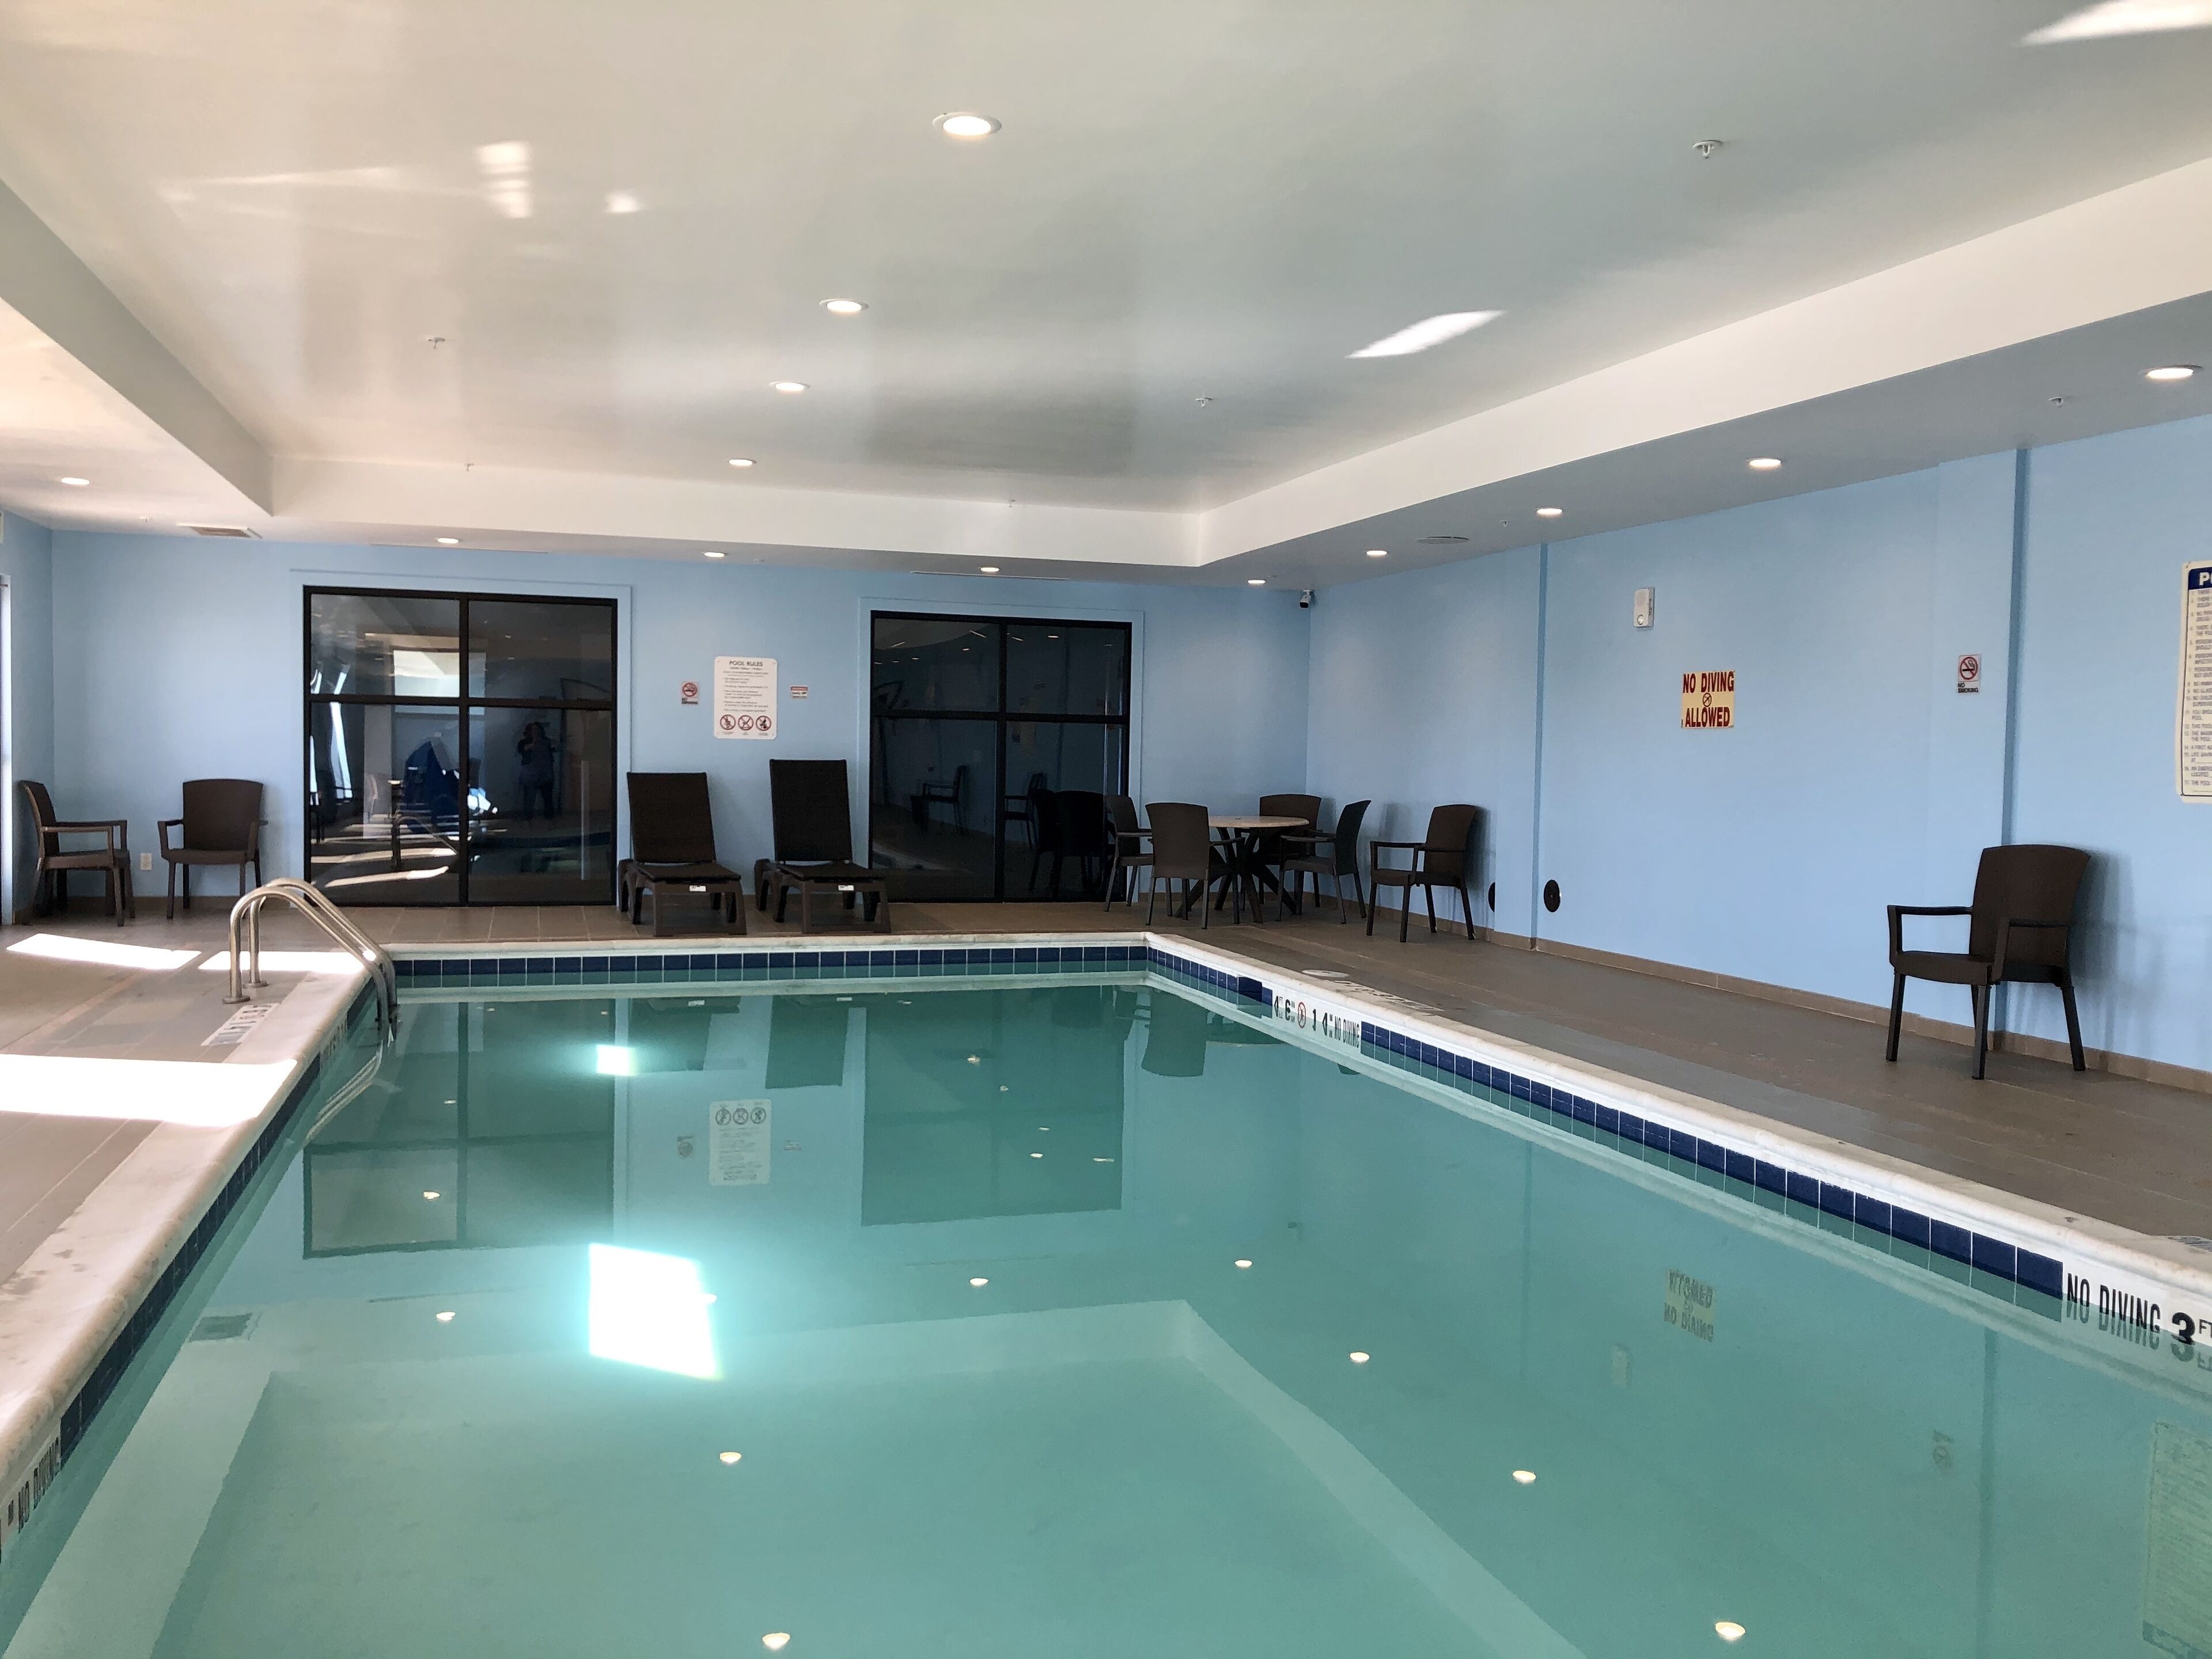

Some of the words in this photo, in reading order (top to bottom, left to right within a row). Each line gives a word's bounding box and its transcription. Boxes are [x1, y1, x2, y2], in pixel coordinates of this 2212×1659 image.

[1683, 673, 1696, 694] NO
[1701, 671, 1734, 693] DIVING
[1685, 707, 1730, 728] ALLOWED
[1335, 1016, 1342, 1030] NO
[2067, 1273, 2090, 1308] NO
[2099, 1284, 2161, 1334] DIVING
[2172, 1312, 2196, 1345] 3
